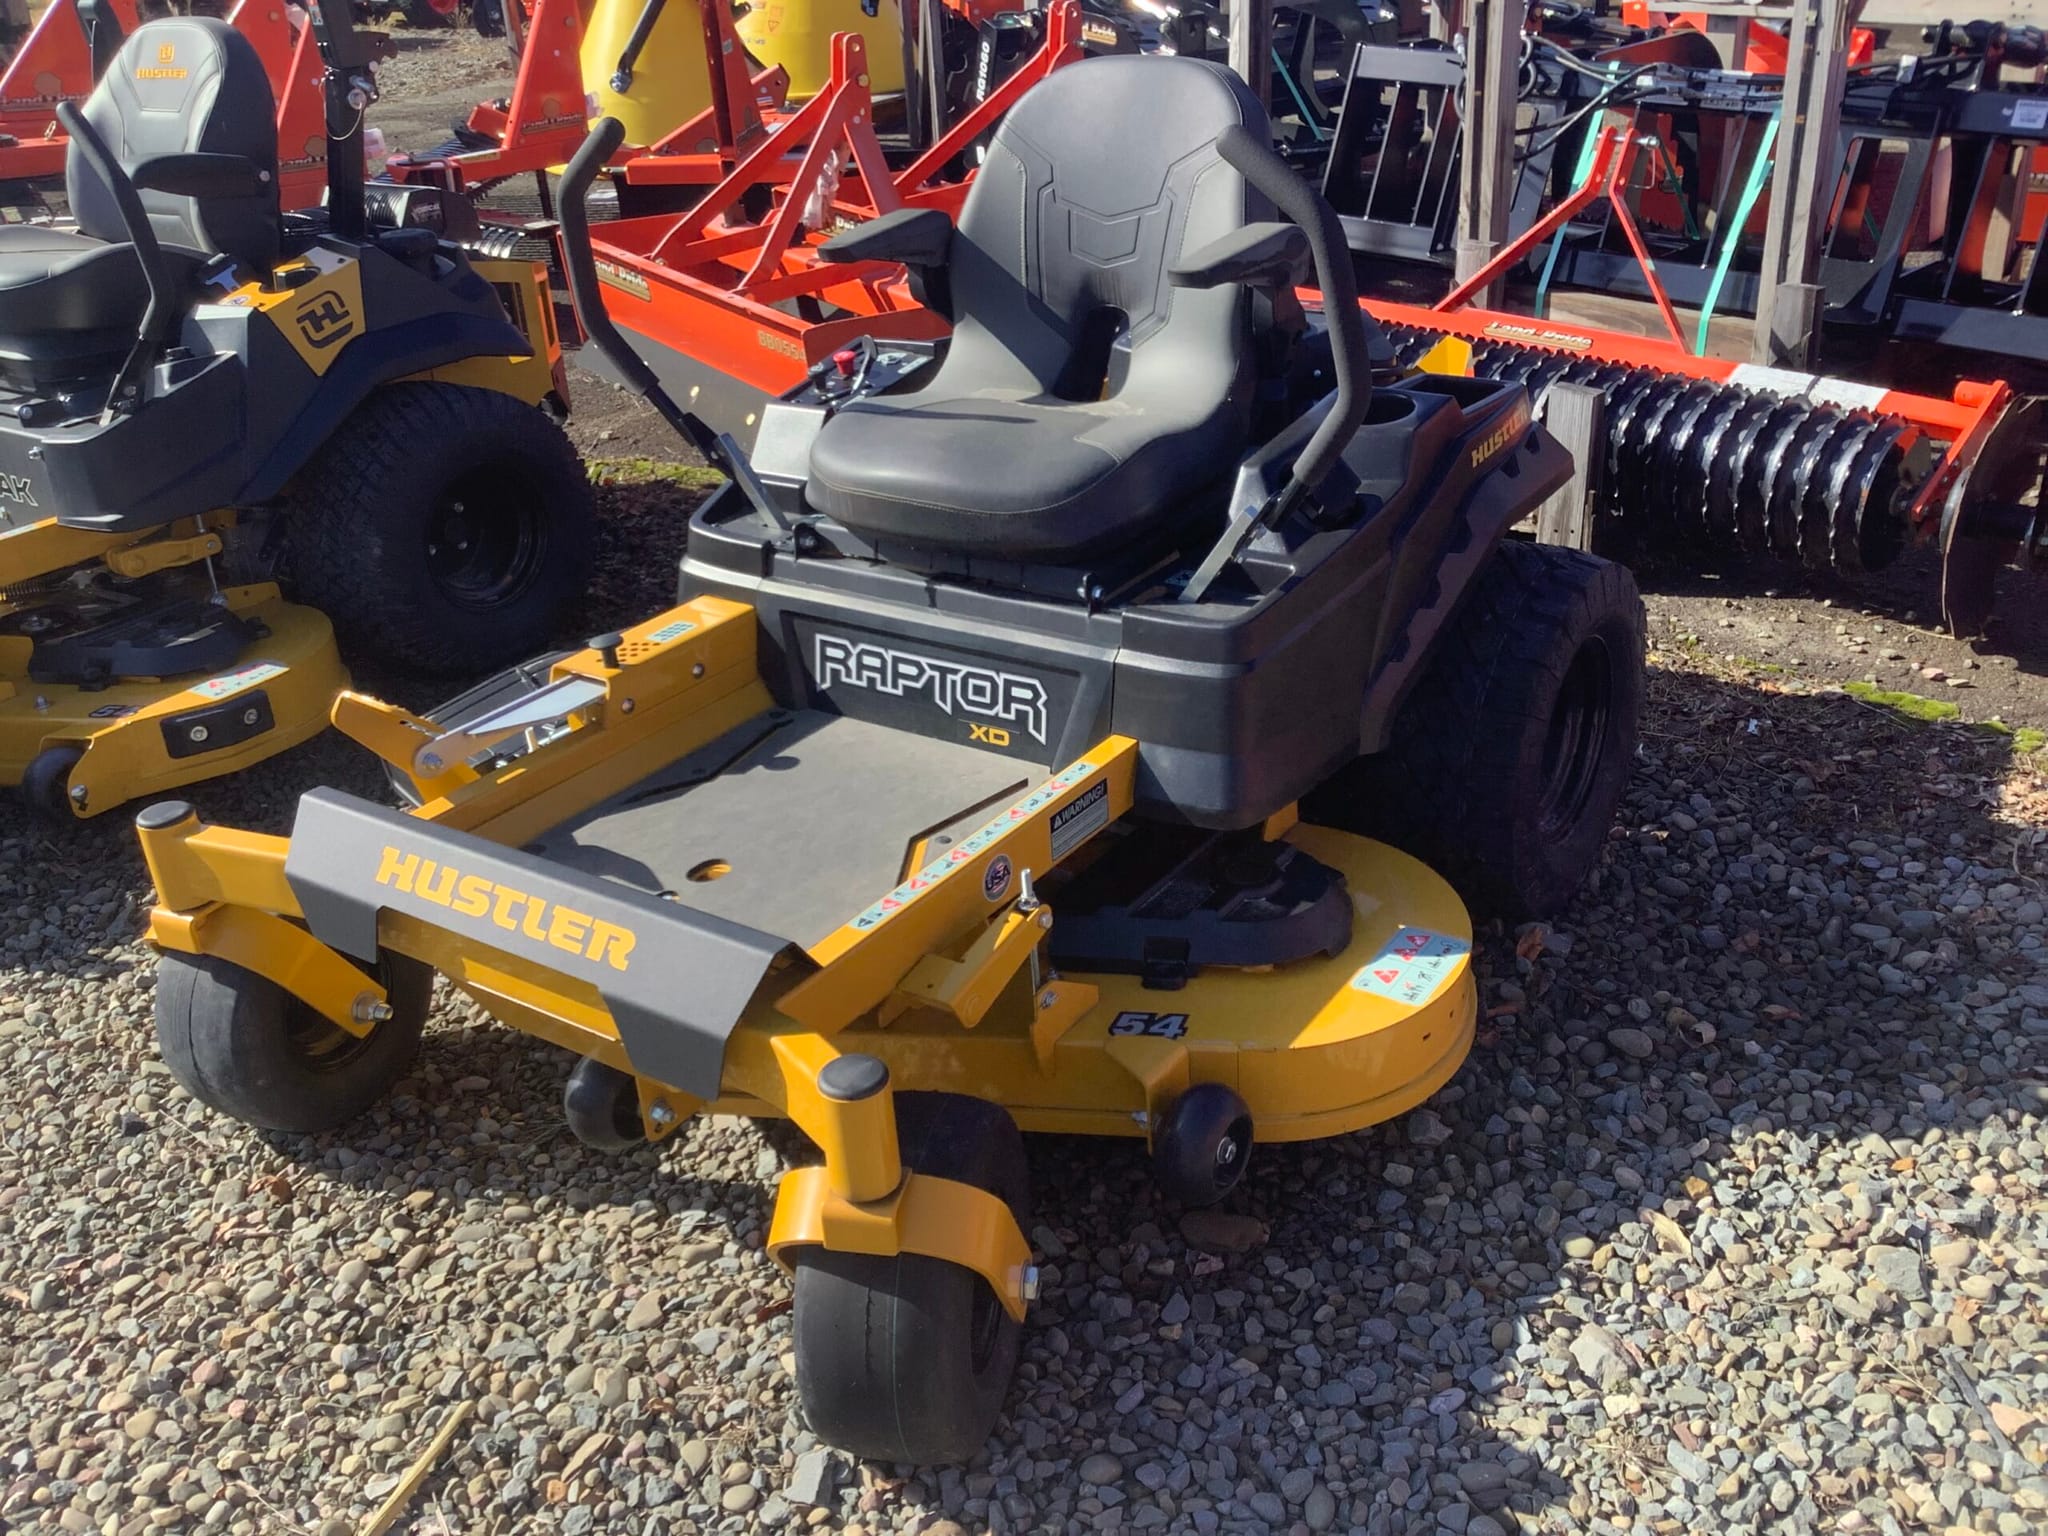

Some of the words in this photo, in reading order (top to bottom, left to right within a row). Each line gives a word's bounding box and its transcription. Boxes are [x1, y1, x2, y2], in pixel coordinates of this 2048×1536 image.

[815, 633, 1048, 746] RAPTOR
[969, 723, 1010, 747] XD
[1060, 782, 1105, 823] WARNING!
[986, 864, 1011, 891] USA
[375, 845, 637, 972] HUSTLER
[1110, 1012, 1187, 1038] 54
